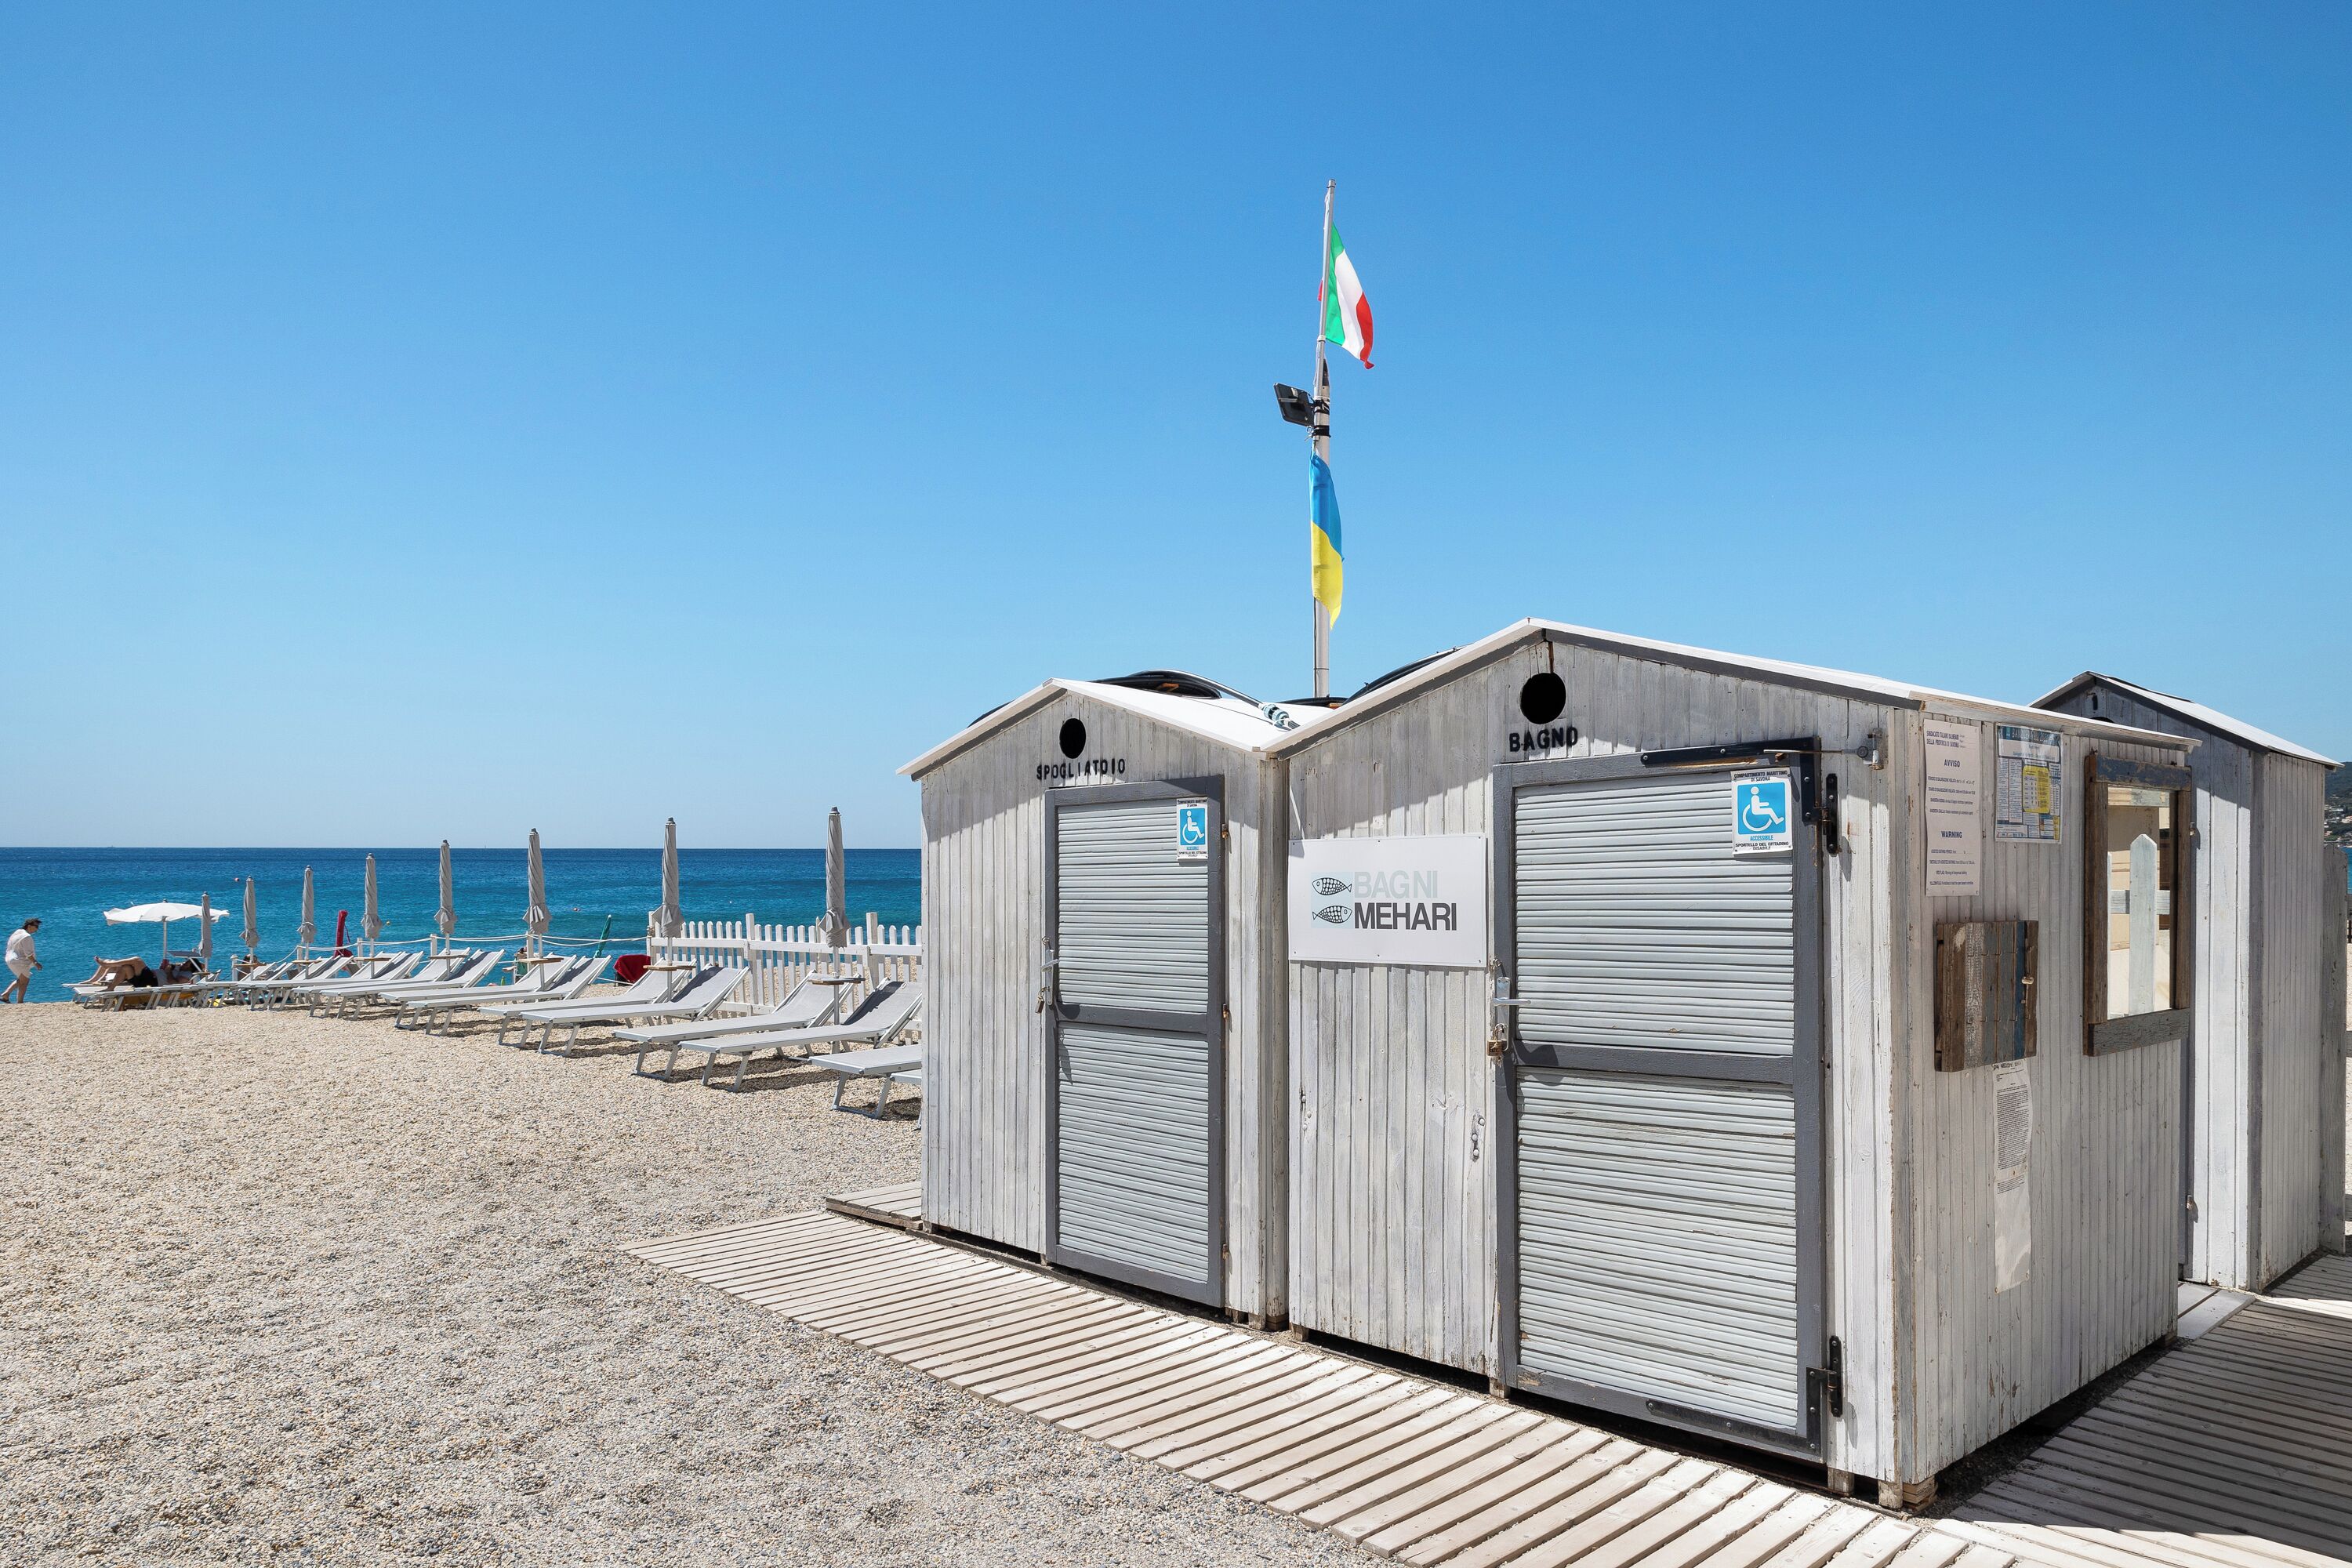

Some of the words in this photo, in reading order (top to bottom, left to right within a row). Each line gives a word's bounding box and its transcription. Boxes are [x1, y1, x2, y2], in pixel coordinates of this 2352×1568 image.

[1509, 727, 1578, 752] BAGNO
[1036, 758, 1125, 780] SPOGLIATOIO
[1944, 759, 1961, 768] AVVISO
[1355, 870, 1438, 899] BAGNI
[1354, 902, 1457, 931] MEHARI
